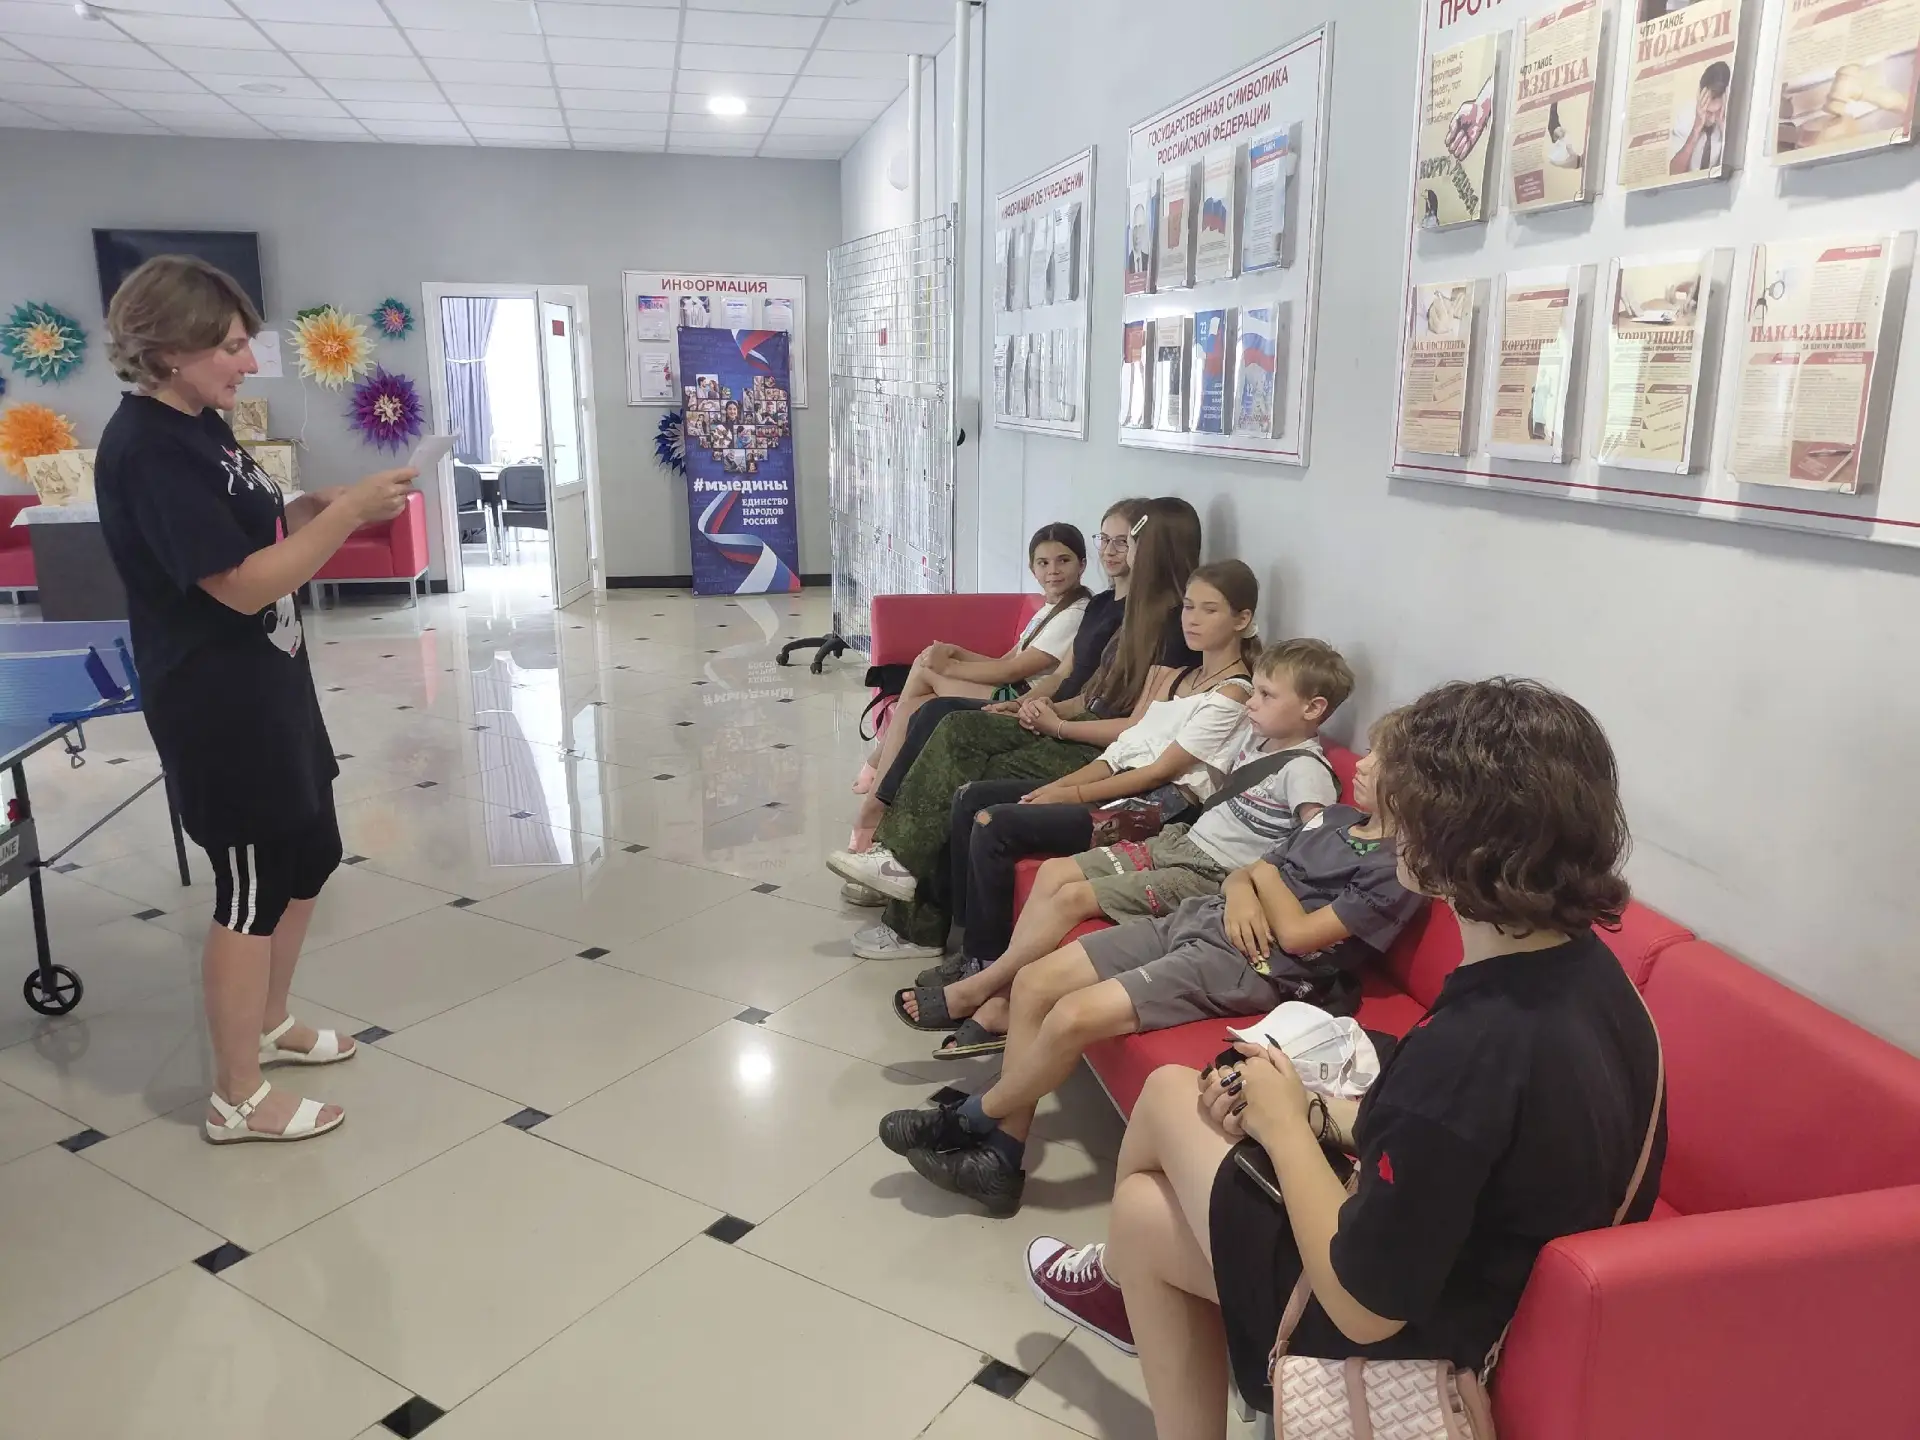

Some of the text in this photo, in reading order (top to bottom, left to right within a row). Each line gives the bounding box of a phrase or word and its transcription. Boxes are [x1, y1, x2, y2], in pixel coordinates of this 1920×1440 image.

[1637, 10, 1732, 64] ПОДКУП
[1517, 56, 1590, 101] ВЗЯТКА
[1147, 64, 1289, 148] ГОСУДАРСТВЕННАЯ СИМВОЛИКА
[1157, 101, 1271, 167] РОССИЙСКОЙ ФЕДЕРАЦИИ
[1002, 170, 1084, 219] ИНФОРМАЦИЯ ОБ УЧРЕЖДЕНИИ
[661, 278, 768, 294] ИНФОРМАЦИЯ
[1750, 322, 1867, 344] НАКАЗАНИЕ
[693, 478, 789, 494] #мыедины
[741, 497, 789, 508] ЕДИНСТВО
[742, 508, 784, 517] НАРОДОВ
[743, 518, 778, 526] РОССИИ
